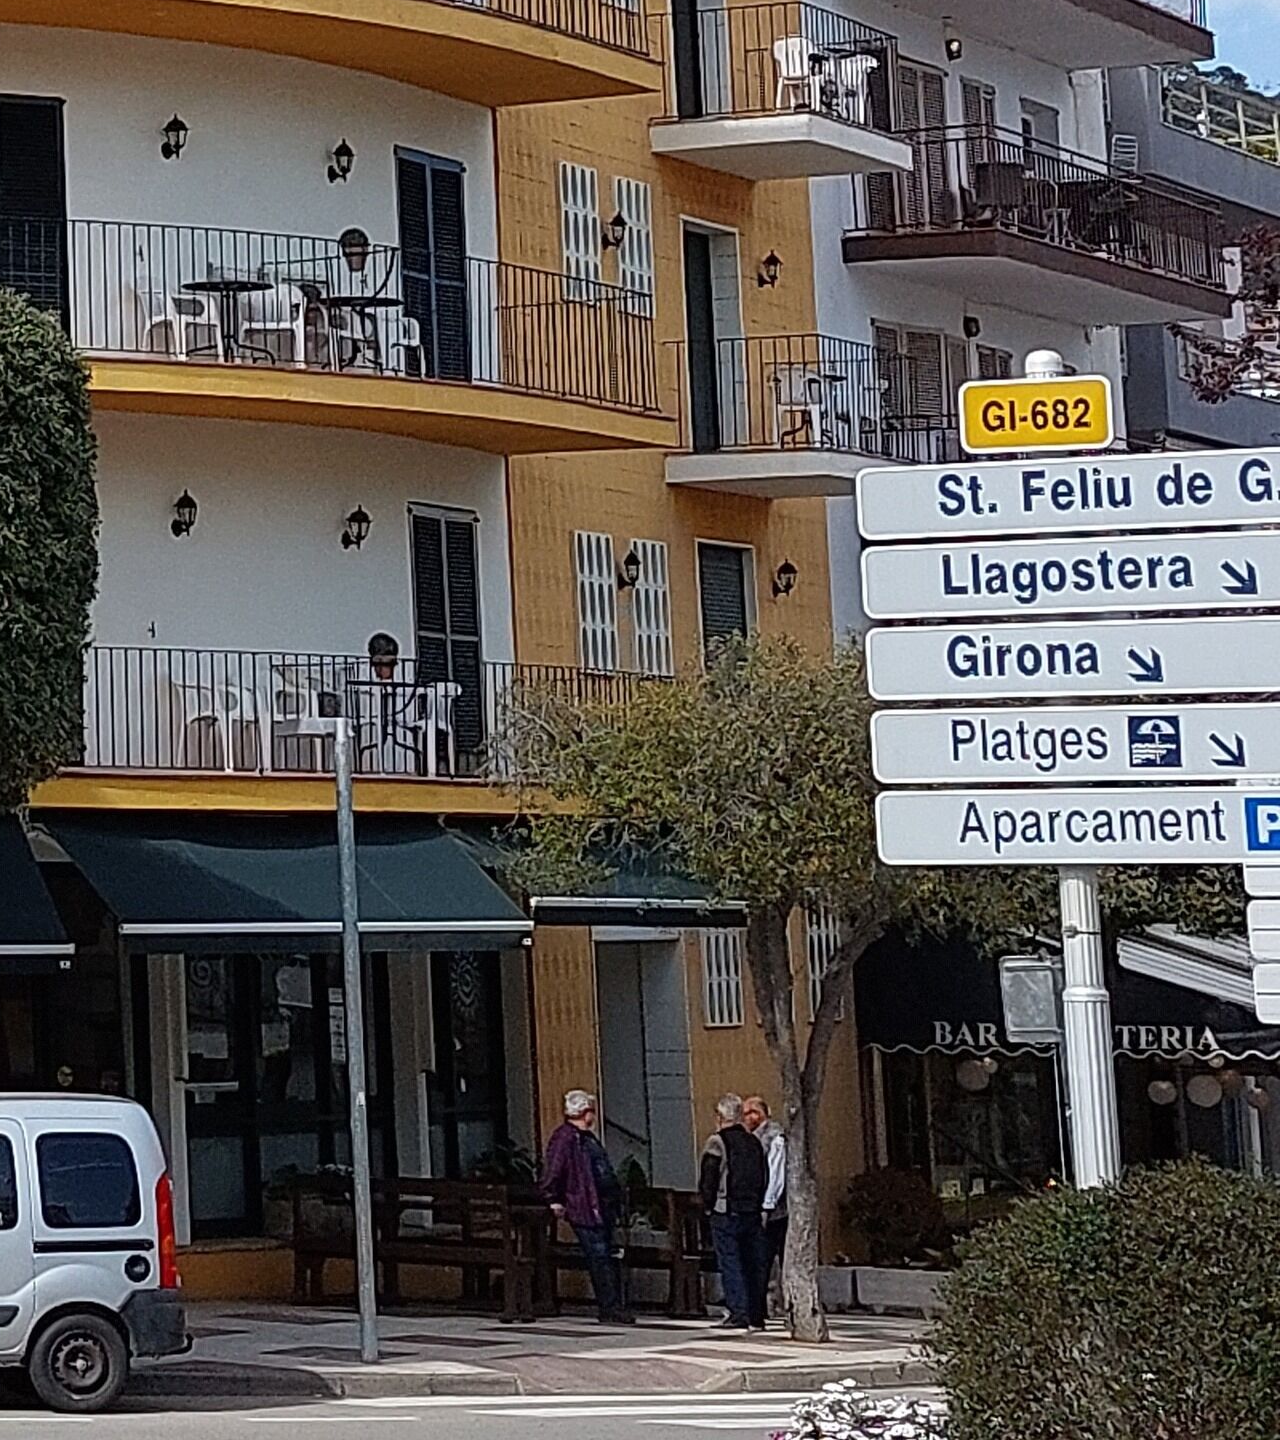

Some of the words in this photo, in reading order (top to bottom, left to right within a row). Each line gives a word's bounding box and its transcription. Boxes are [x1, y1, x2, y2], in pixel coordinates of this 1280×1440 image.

[982, 397, 1092, 432] GI-682
[939, 473, 998, 516] St.
[1022, 467, 1132, 512] Feliu
[1157, 463, 1212, 506] de
[942, 549, 1194, 604] Llagostera
[947, 635, 1100, 678] Girona
[951, 719, 1108, 772] Platges
[959, 800, 1227, 854] Aparcament
[933, 1021, 1000, 1046] BAR
